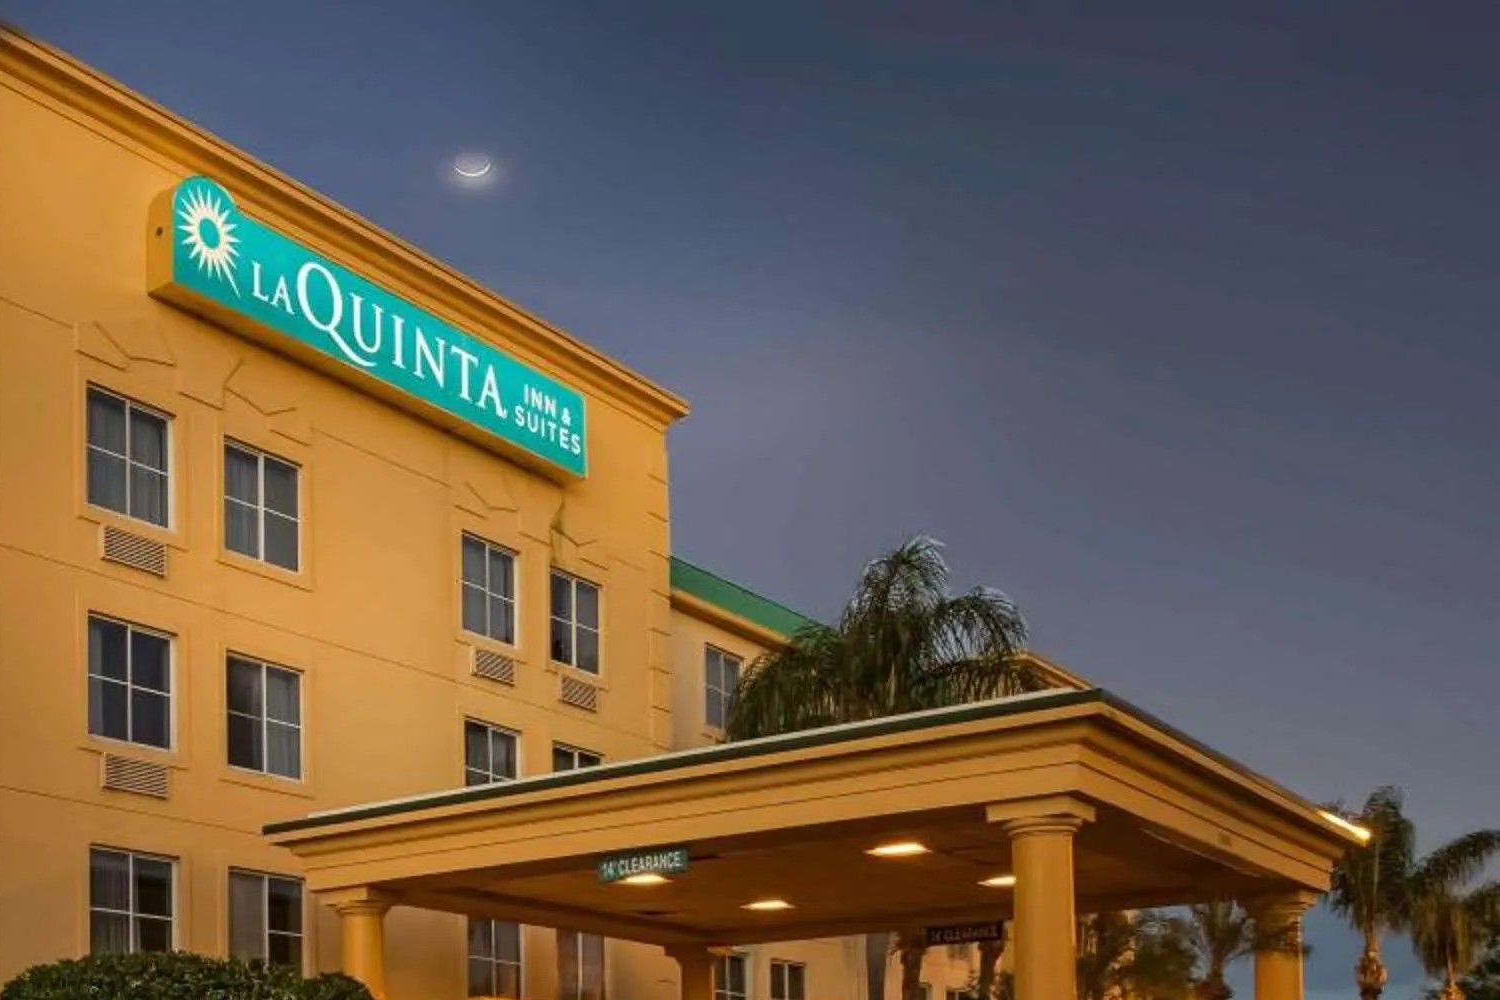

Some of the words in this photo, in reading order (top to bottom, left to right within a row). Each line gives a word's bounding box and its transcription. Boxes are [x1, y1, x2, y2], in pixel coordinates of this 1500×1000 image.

[251, 260, 295, 316] LA
[297, 261, 508, 418] QUINTA
[523, 383, 557, 419] INN
[561, 407, 572, 427] &
[514, 404, 581, 455] SUITES
[618, 851, 683, 876] CLEARANCE
